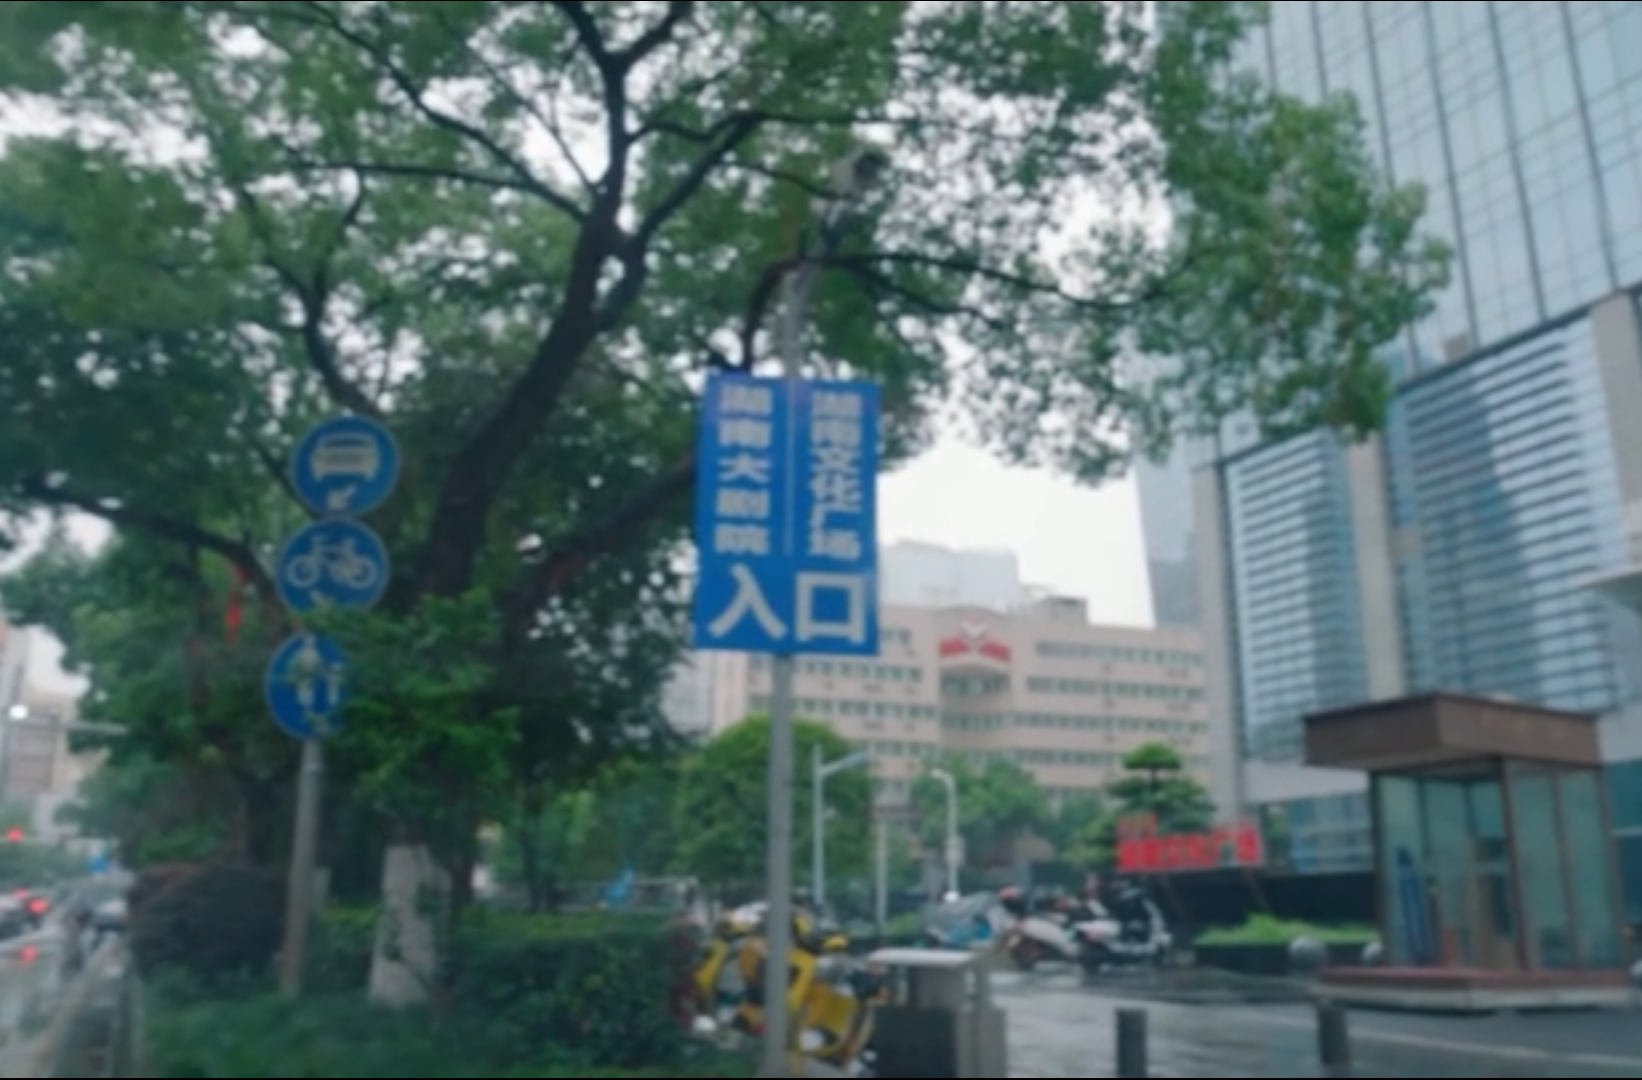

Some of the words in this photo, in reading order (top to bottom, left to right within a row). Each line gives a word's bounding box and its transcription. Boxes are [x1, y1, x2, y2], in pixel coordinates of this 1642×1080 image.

[716, 385, 771, 554] 湖南大剧院
[709, 564, 866, 643] 入口
